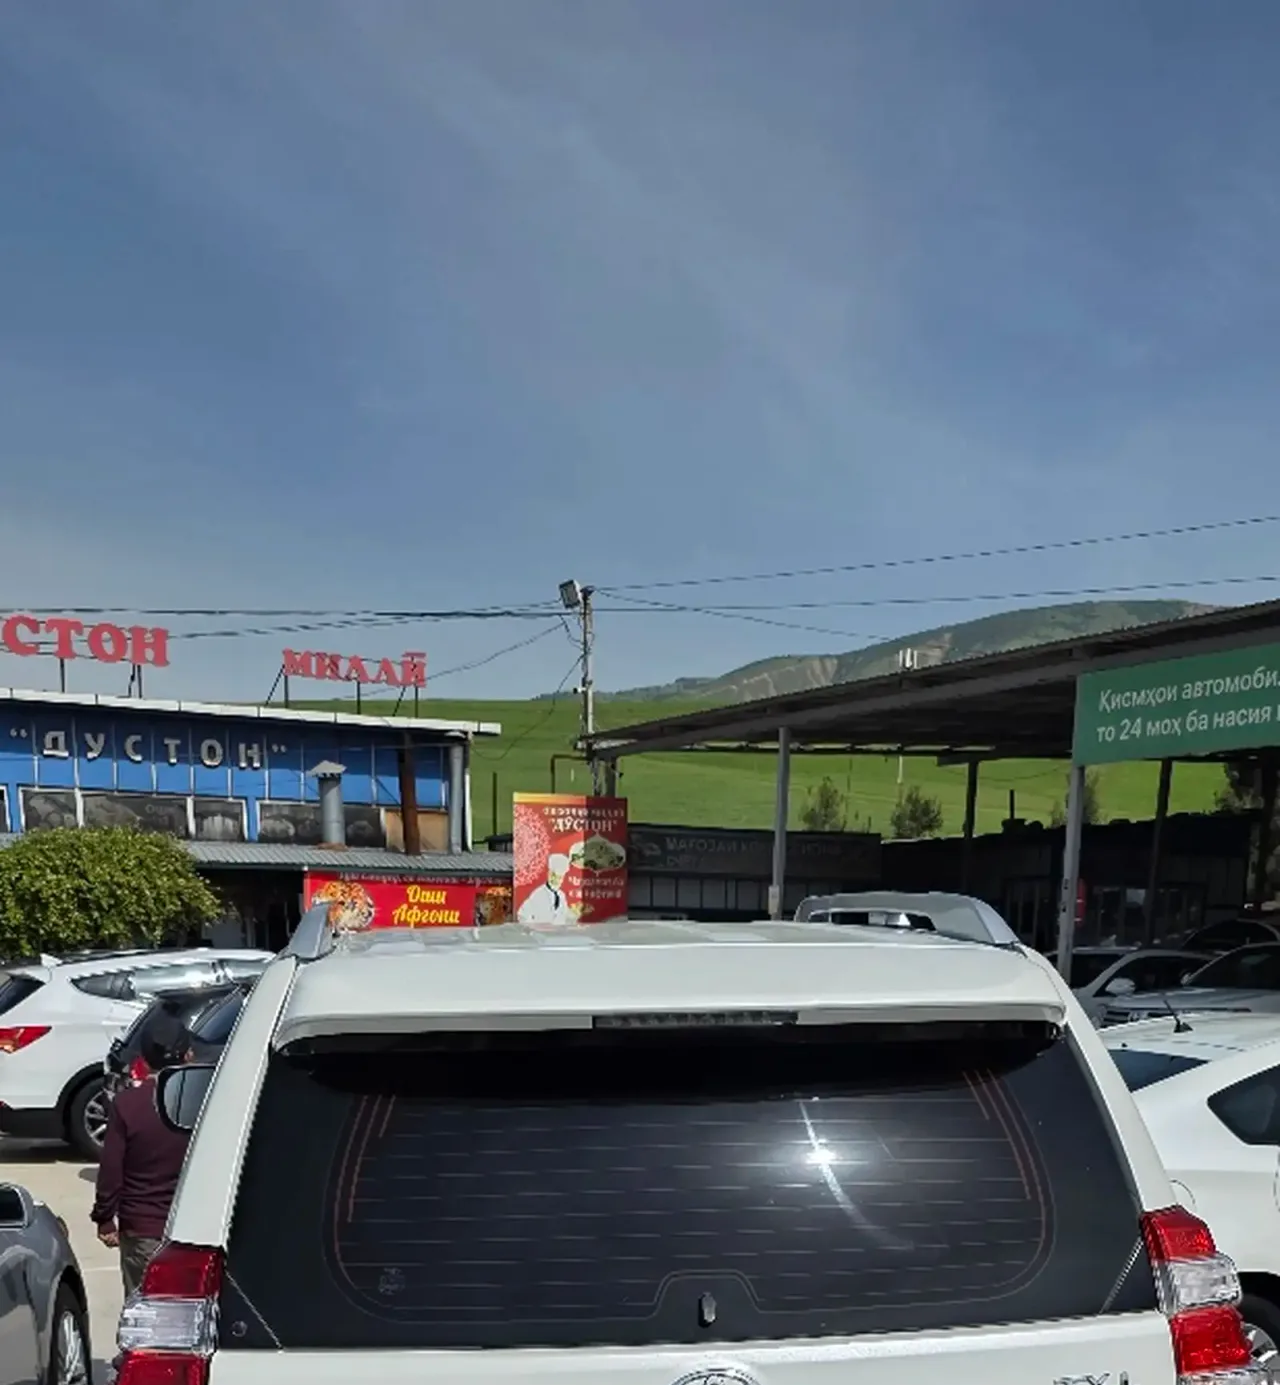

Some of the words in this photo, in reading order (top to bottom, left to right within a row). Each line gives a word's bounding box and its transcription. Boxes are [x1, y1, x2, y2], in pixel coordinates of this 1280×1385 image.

[1097, 725, 1116, 743] то
[1120, 717, 1142, 741] 24
[1146, 717, 1182, 737] моҳ
[1186, 709, 1209, 732] ба
[1212, 704, 1272, 730] насия
